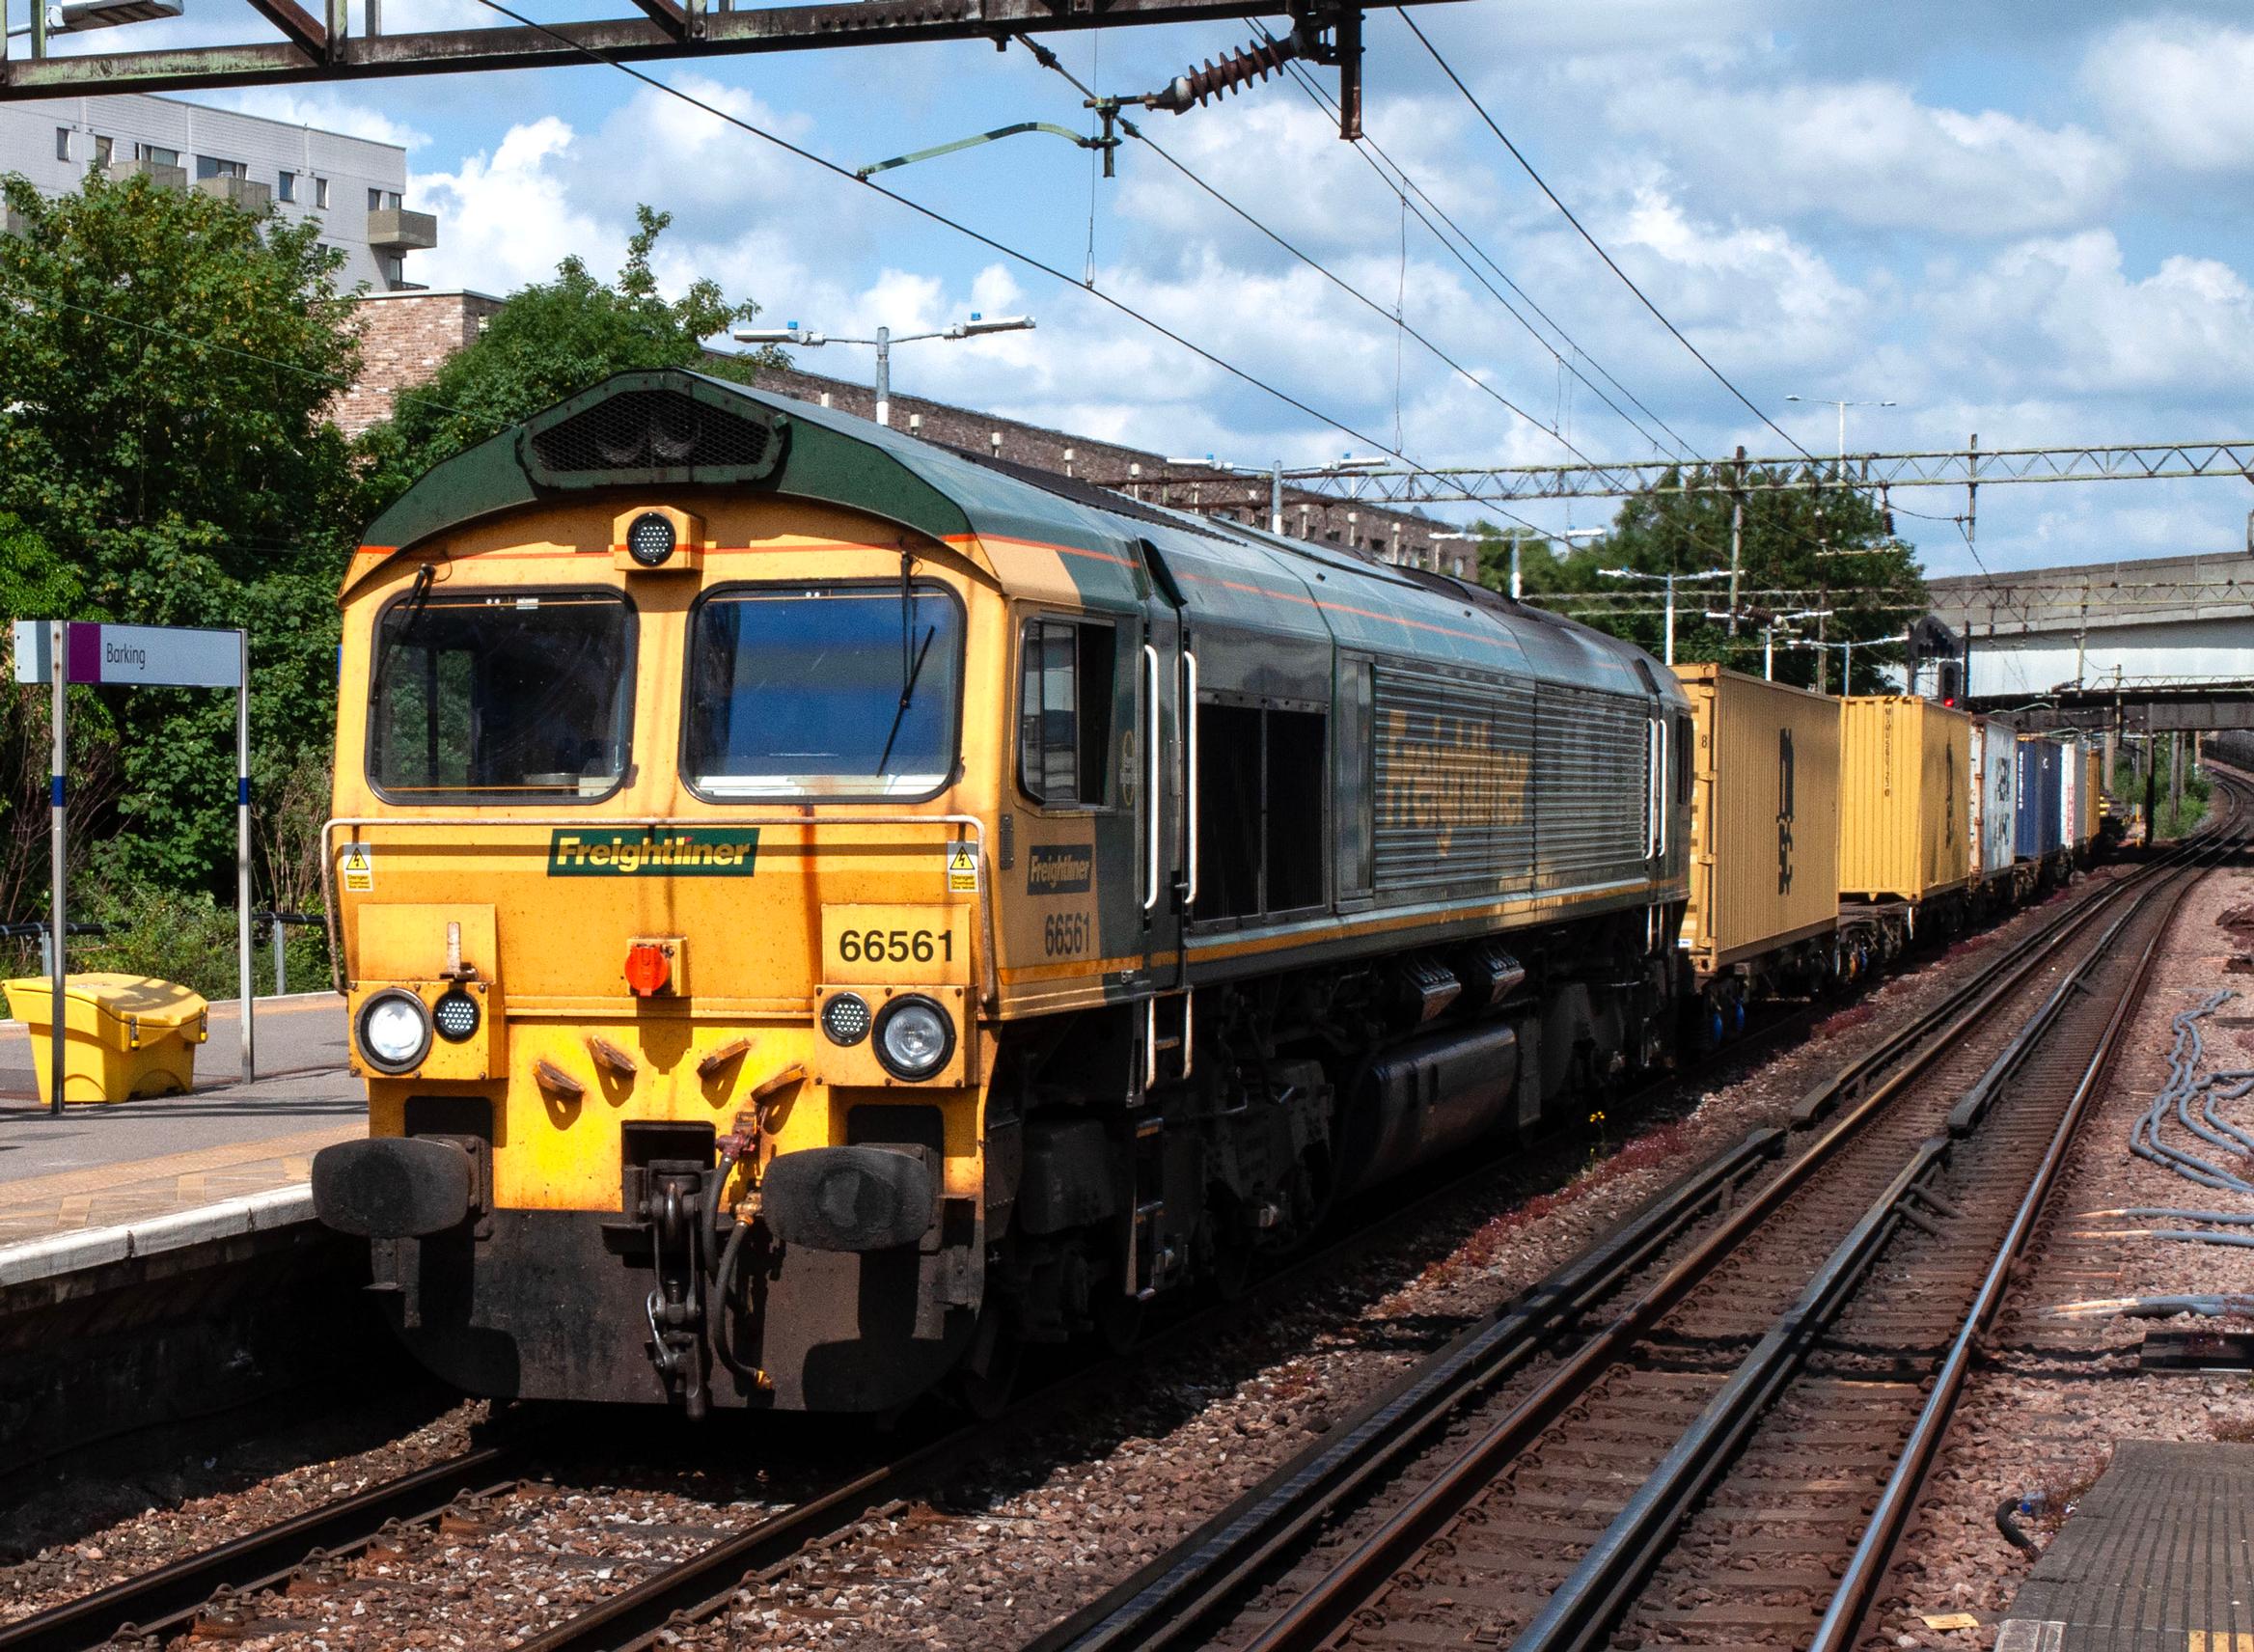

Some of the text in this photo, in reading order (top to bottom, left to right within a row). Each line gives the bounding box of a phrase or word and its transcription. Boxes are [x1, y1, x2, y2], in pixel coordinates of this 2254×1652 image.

[106, 643, 146, 670] Barking
[556, 837, 751, 872] Freightliner
[1031, 854, 1090, 888] Freightliner
[838, 929, 953, 963] 66561
[1045, 911, 1089, 957] 66561
